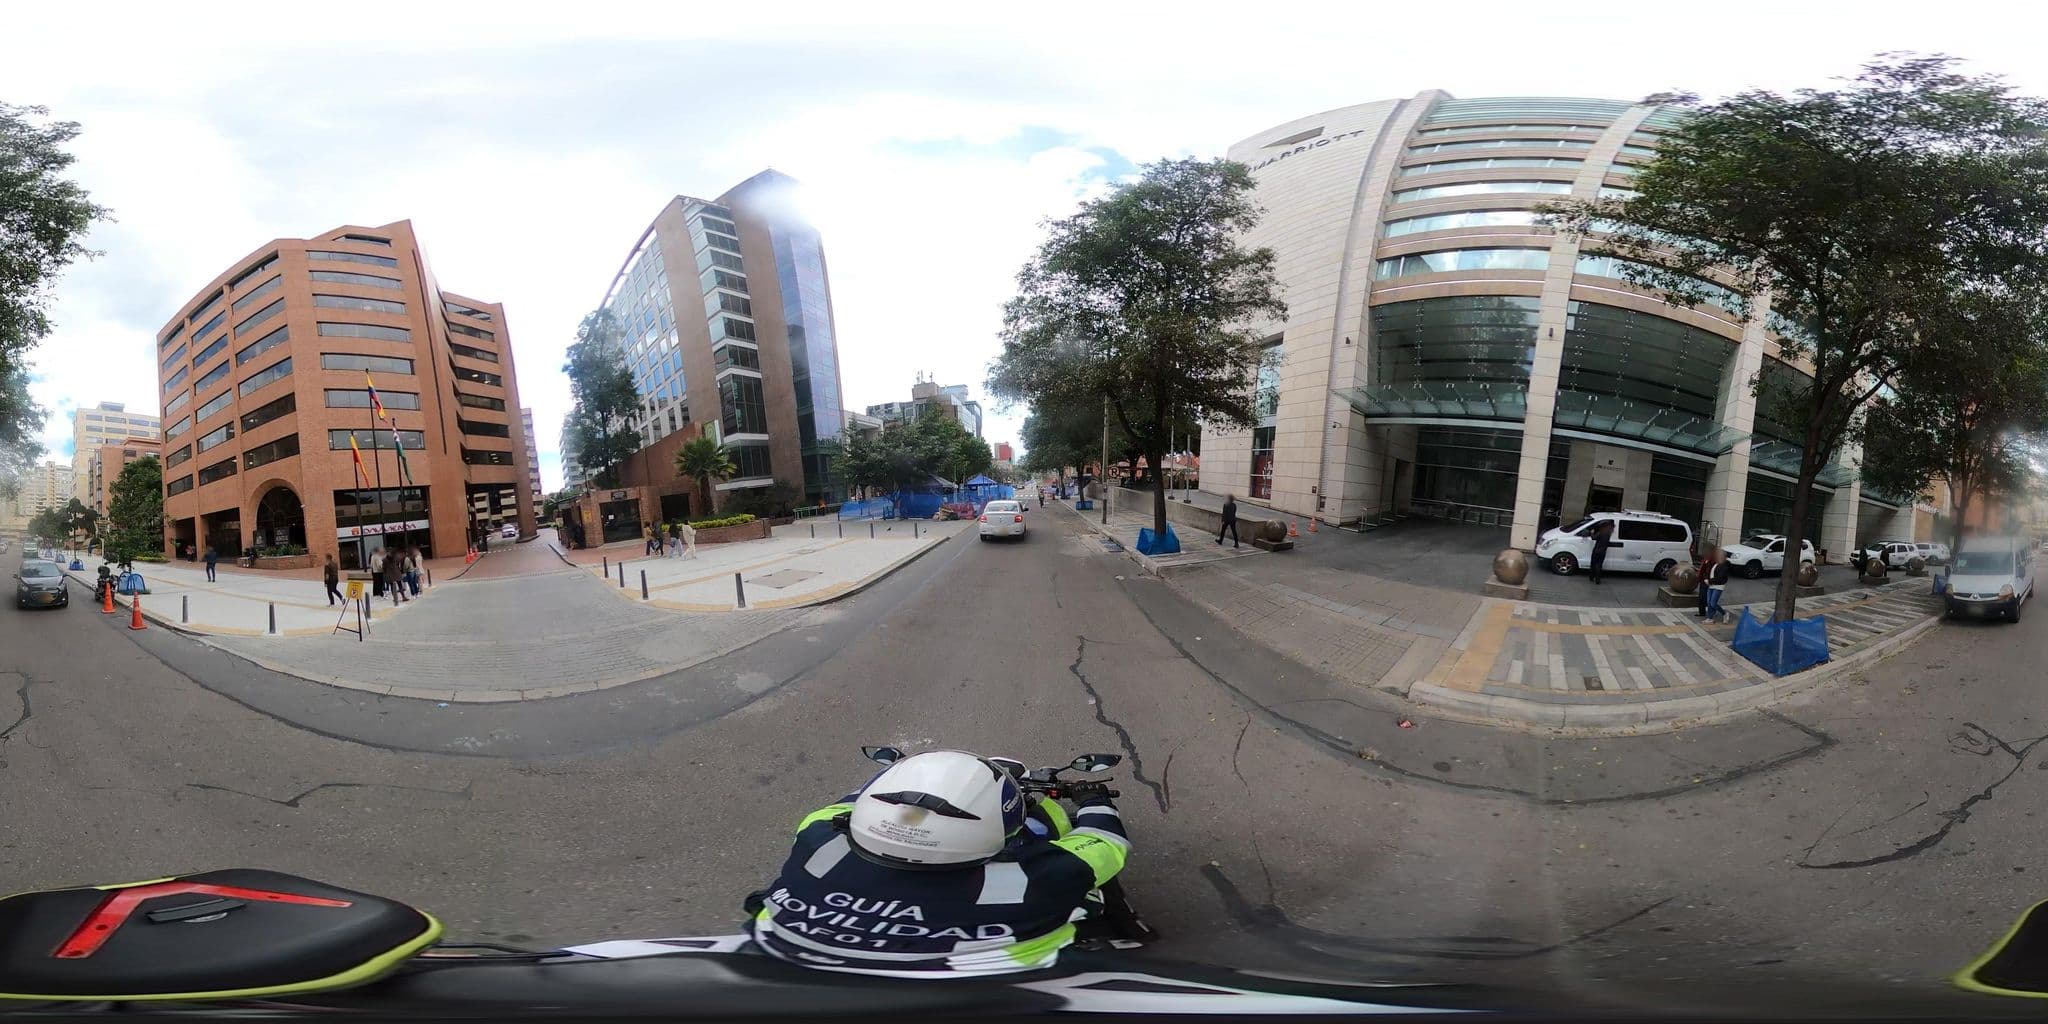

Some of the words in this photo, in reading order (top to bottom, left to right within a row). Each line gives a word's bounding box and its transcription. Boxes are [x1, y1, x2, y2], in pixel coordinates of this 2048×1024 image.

[1253, 130, 1364, 172] MARRIOTT
[771, 887, 1014, 940] MOVILIDAD
[823, 892, 924, 921] GUÍA
